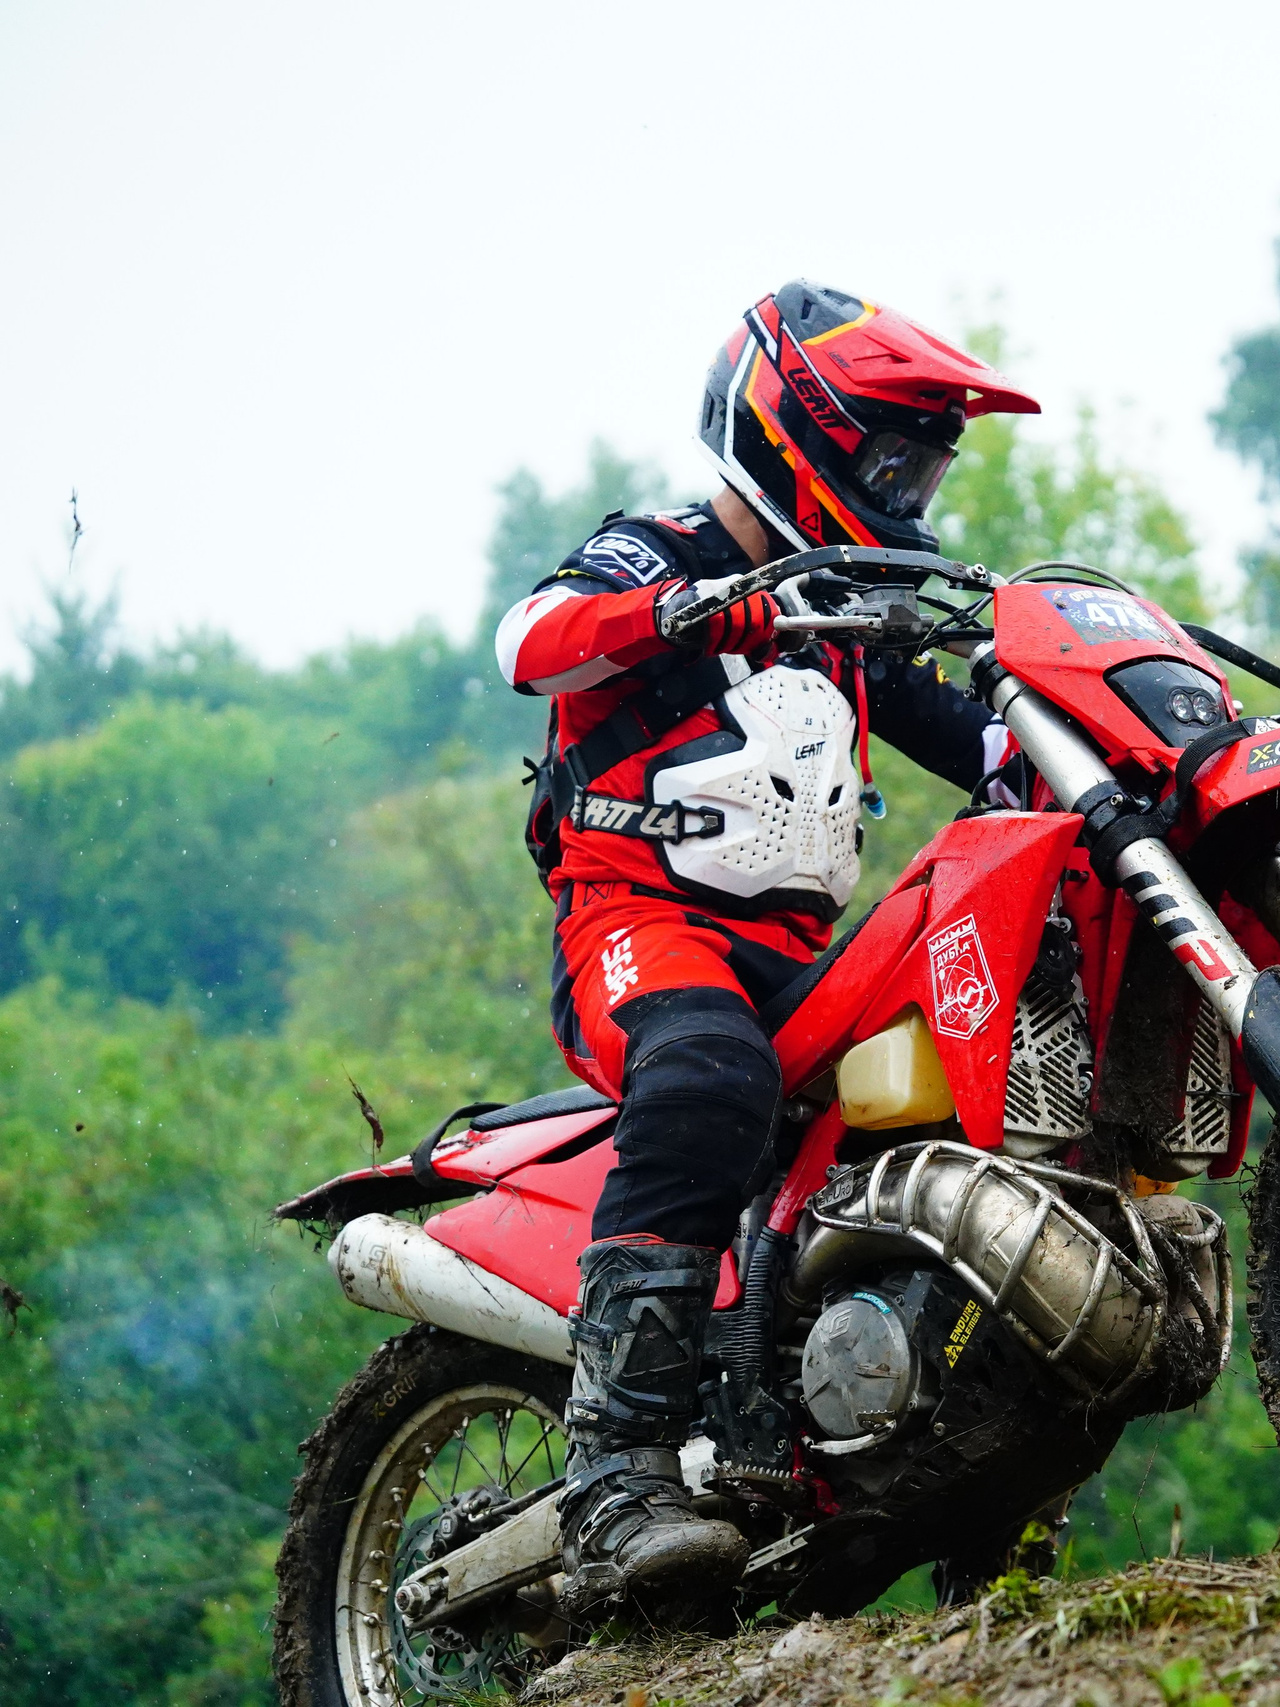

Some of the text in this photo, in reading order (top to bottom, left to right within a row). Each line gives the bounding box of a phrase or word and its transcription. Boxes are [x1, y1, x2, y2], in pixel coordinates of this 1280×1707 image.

[787, 367, 851, 431] LEATT
[594, 538, 656, 570] 100%
[795, 741, 826, 761] LEATT
[1259, 758, 1278, 769] STAY
[950, 1299, 977, 1343] ENDURO
[959, 1305, 983, 1345] ELEMENT
